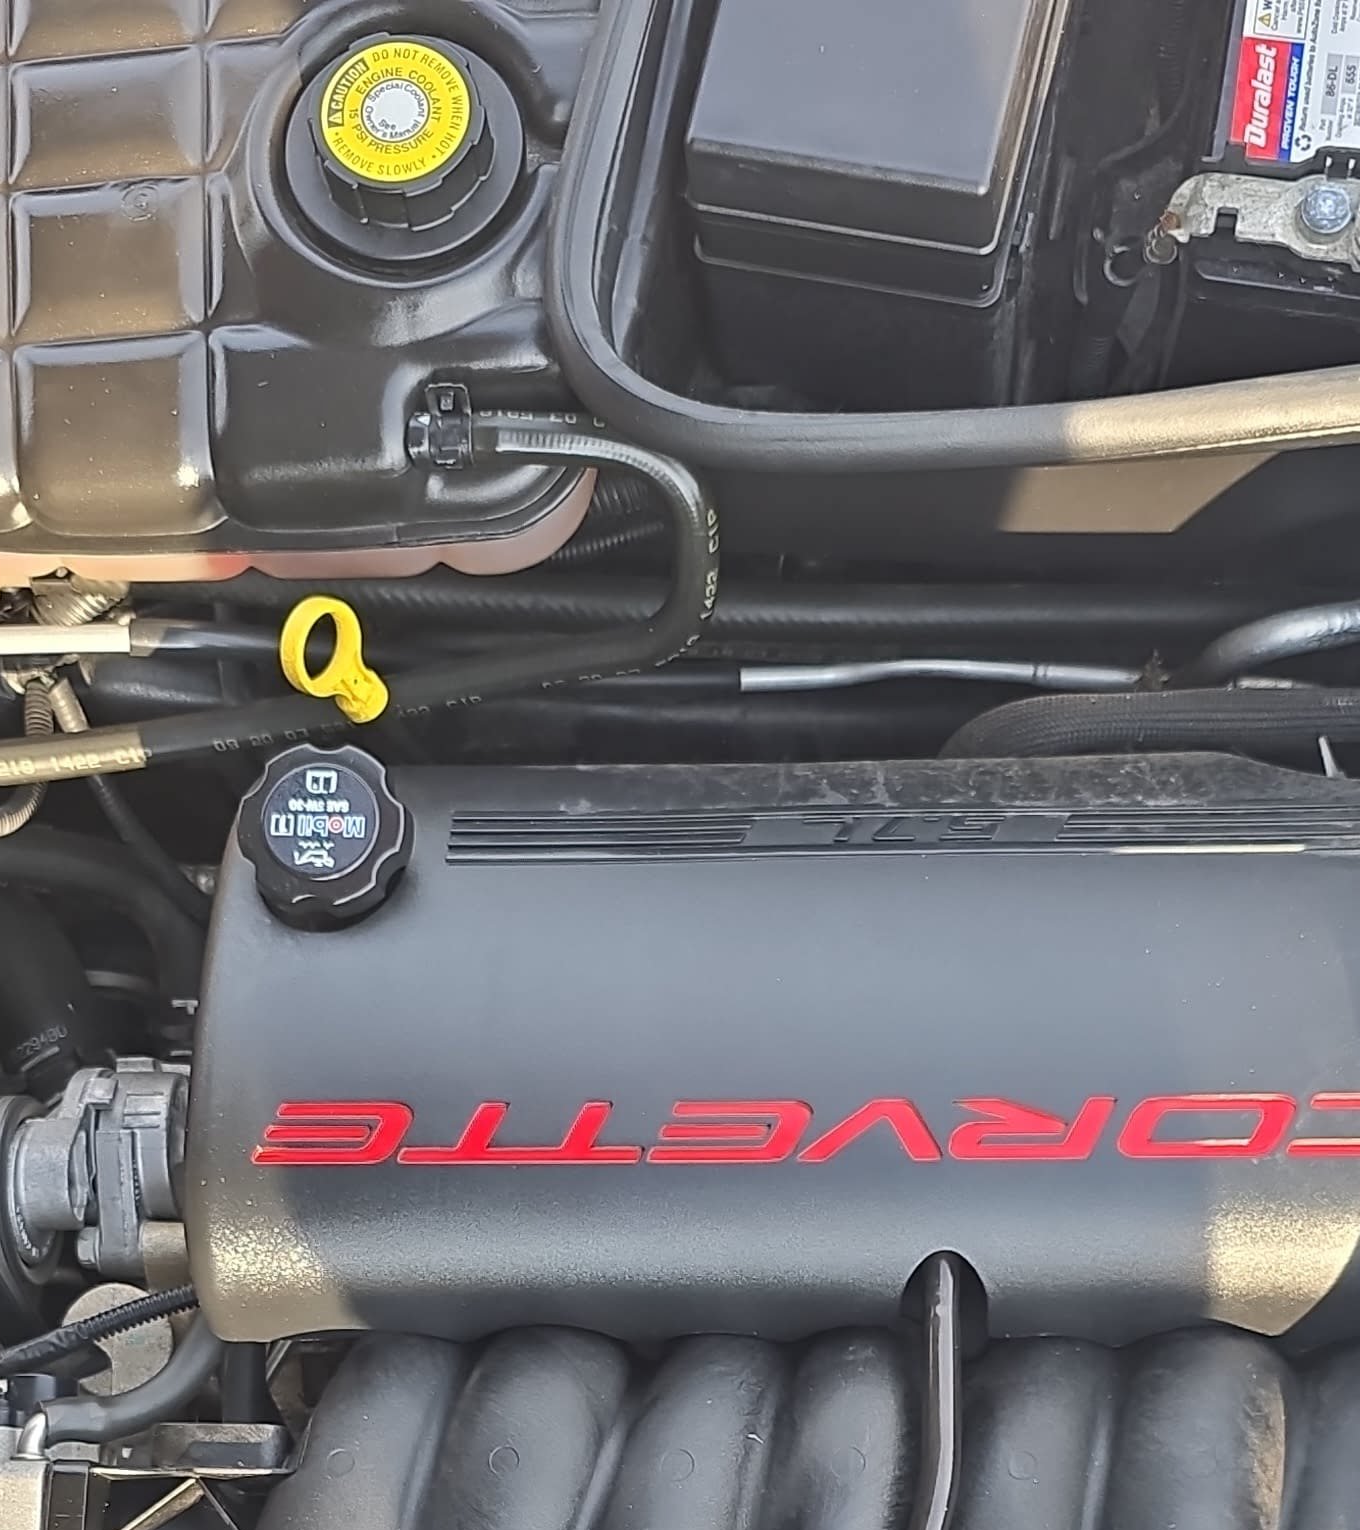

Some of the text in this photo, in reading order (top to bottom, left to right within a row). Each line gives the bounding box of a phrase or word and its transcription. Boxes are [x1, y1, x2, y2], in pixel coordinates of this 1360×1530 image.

[330, 61, 368, 111] CAUTION
[356, 66, 442, 123] ENGINE COOLANT
[368, 82, 426, 118] Special Coolant
[372, 48, 464, 156] DO NOT REMOVE WHEN HOT
[1243, 43, 1278, 148] Duralast
[1281, 56, 1301, 150] PROVEN TOUGH
[349, 107, 434, 154] 15 PSI PRESSURE
[332, 137, 427, 176] REMOVE SLOWLY
[297, 814, 366, 838] Mobil
